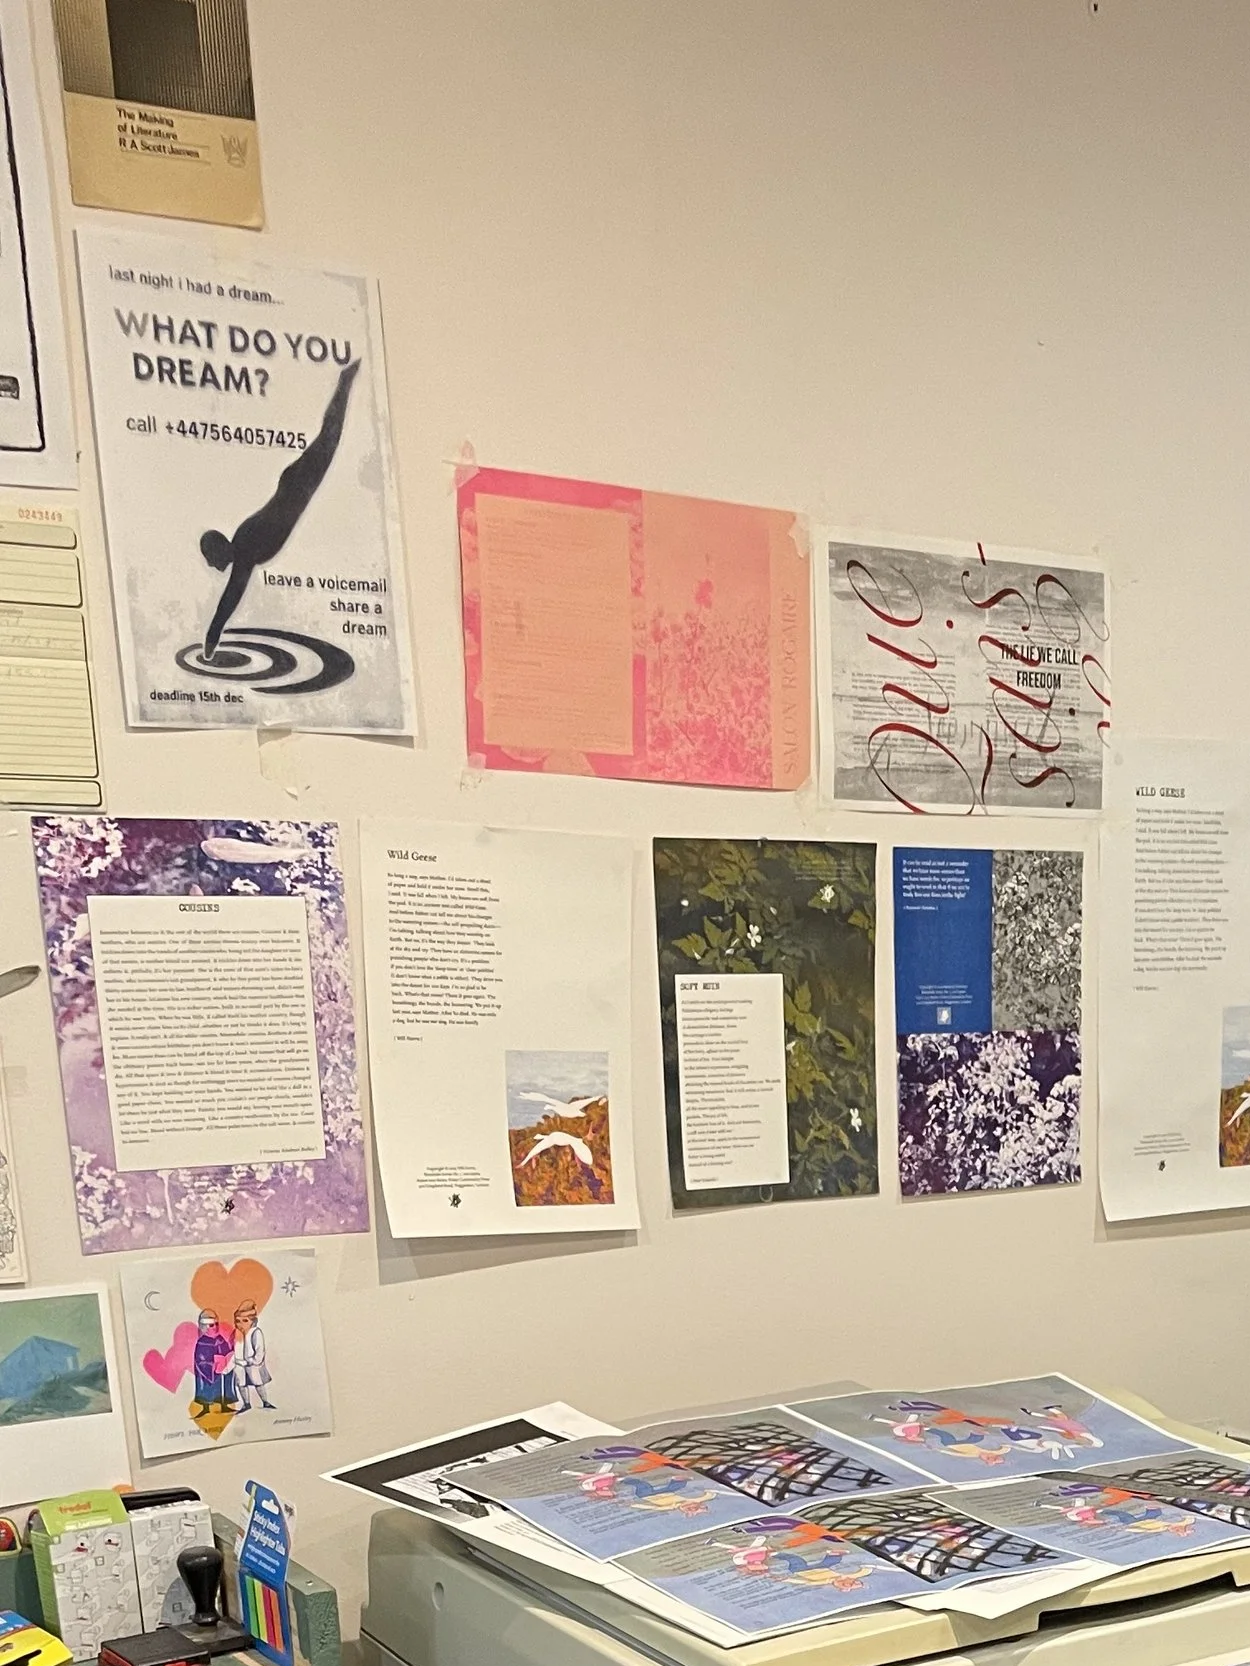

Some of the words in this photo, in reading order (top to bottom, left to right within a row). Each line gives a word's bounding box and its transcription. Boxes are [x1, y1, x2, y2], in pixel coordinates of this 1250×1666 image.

[116, 107, 135, 121] The
[139, 111, 174, 128] Making
[118, 123, 128, 133] of
[131, 126, 178, 141] Literature
[119, 137, 126, 148] R
[130, 139, 138, 150] A
[109, 264, 135, 283] last
[139, 270, 174, 290] night
[178, 277, 182, 290] i
[186, 277, 212, 295] had
[216, 284, 225, 297] a
[114, 307, 218, 350] WHAT
[228, 324, 277, 357] DO
[284, 332, 351, 365] YOU
[132, 352, 270, 397] DREAM?
[126, 415, 157, 434] call
[165, 419, 307, 450] +447564057425
[263, 571, 302, 588] leave
[306, 576, 315, 588] a
[319, 575, 387, 593] voicemail
[330, 599, 370, 614] share
[374, 602, 382, 614] a
[342, 620, 387, 636] dream
[1001, 643, 1019, 660] THE
[1037, 646, 1053, 663] WE
[1054, 648, 1079, 665] CALL
[1016, 671, 1062, 690] FREEDOM
[150, 689, 196, 702] deadline
[198, 691, 221, 703] 15th
[224, 692, 244, 703] dec
[1135, 786, 1156, 797] WILD
[1159, 787, 1186, 799] GEESE
[387, 849, 409, 860] Wild
[411, 851, 437, 862] Geese
[178, 903, 220, 913] COUSINS
